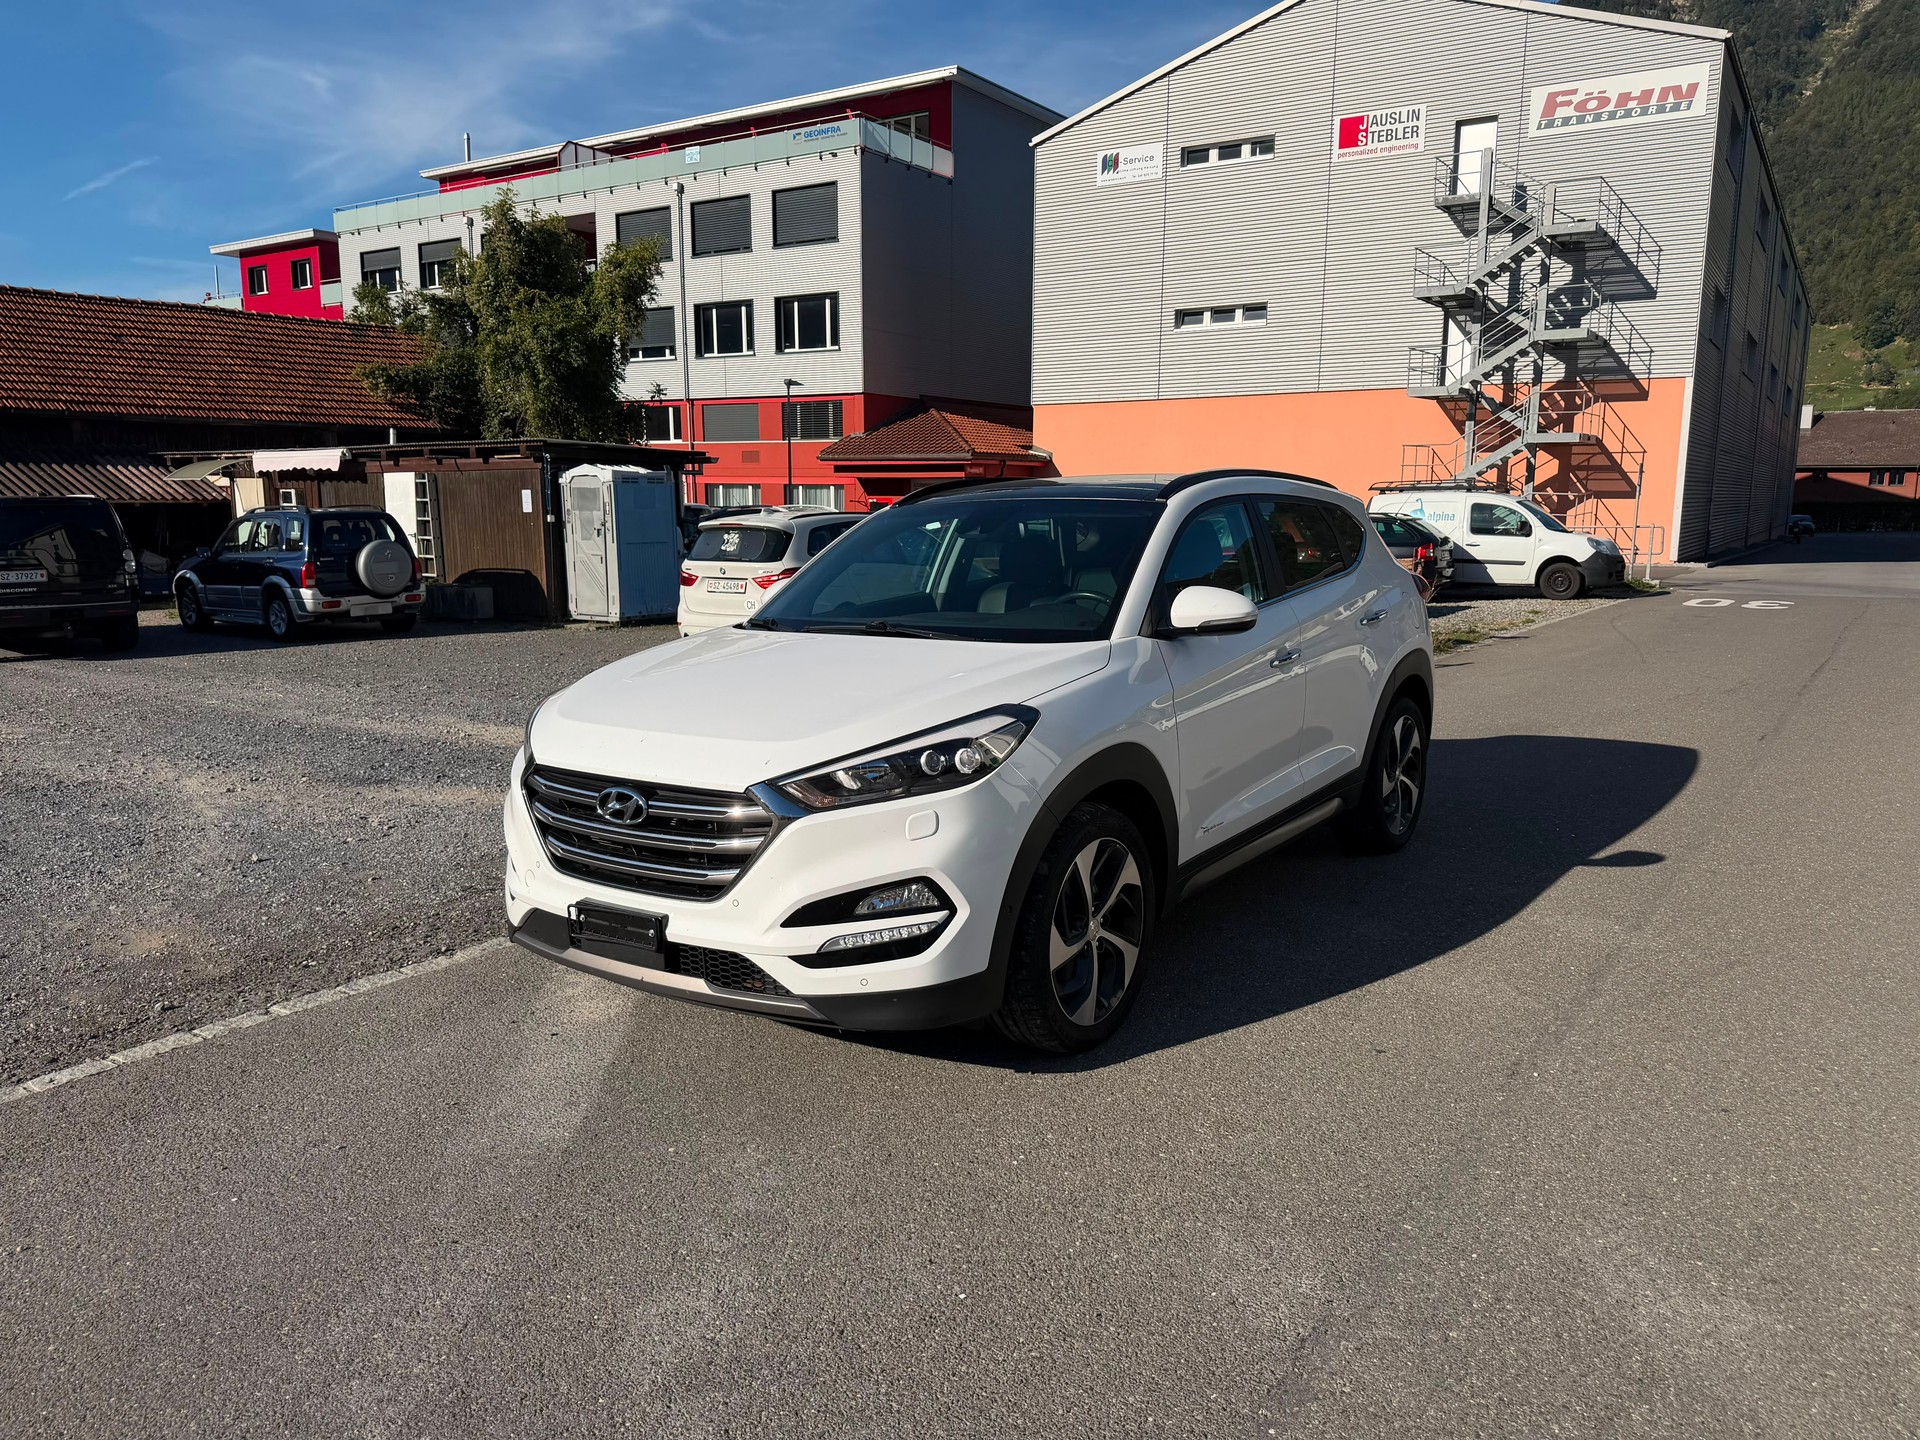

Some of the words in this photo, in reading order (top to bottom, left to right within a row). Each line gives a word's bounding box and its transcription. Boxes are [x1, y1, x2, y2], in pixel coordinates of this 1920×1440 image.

[1540, 82, 1700, 120] FÖHN
[1539, 101, 1693, 129] TRANSPORTE
[803, 125, 842, 139] GEOINFRA
[1337, 147, 1378, 160] personalized
[1380, 142, 1419, 154] engineering
[1427, 511, 1456, 523] alpina
[746, 600, 756, 610] CH
